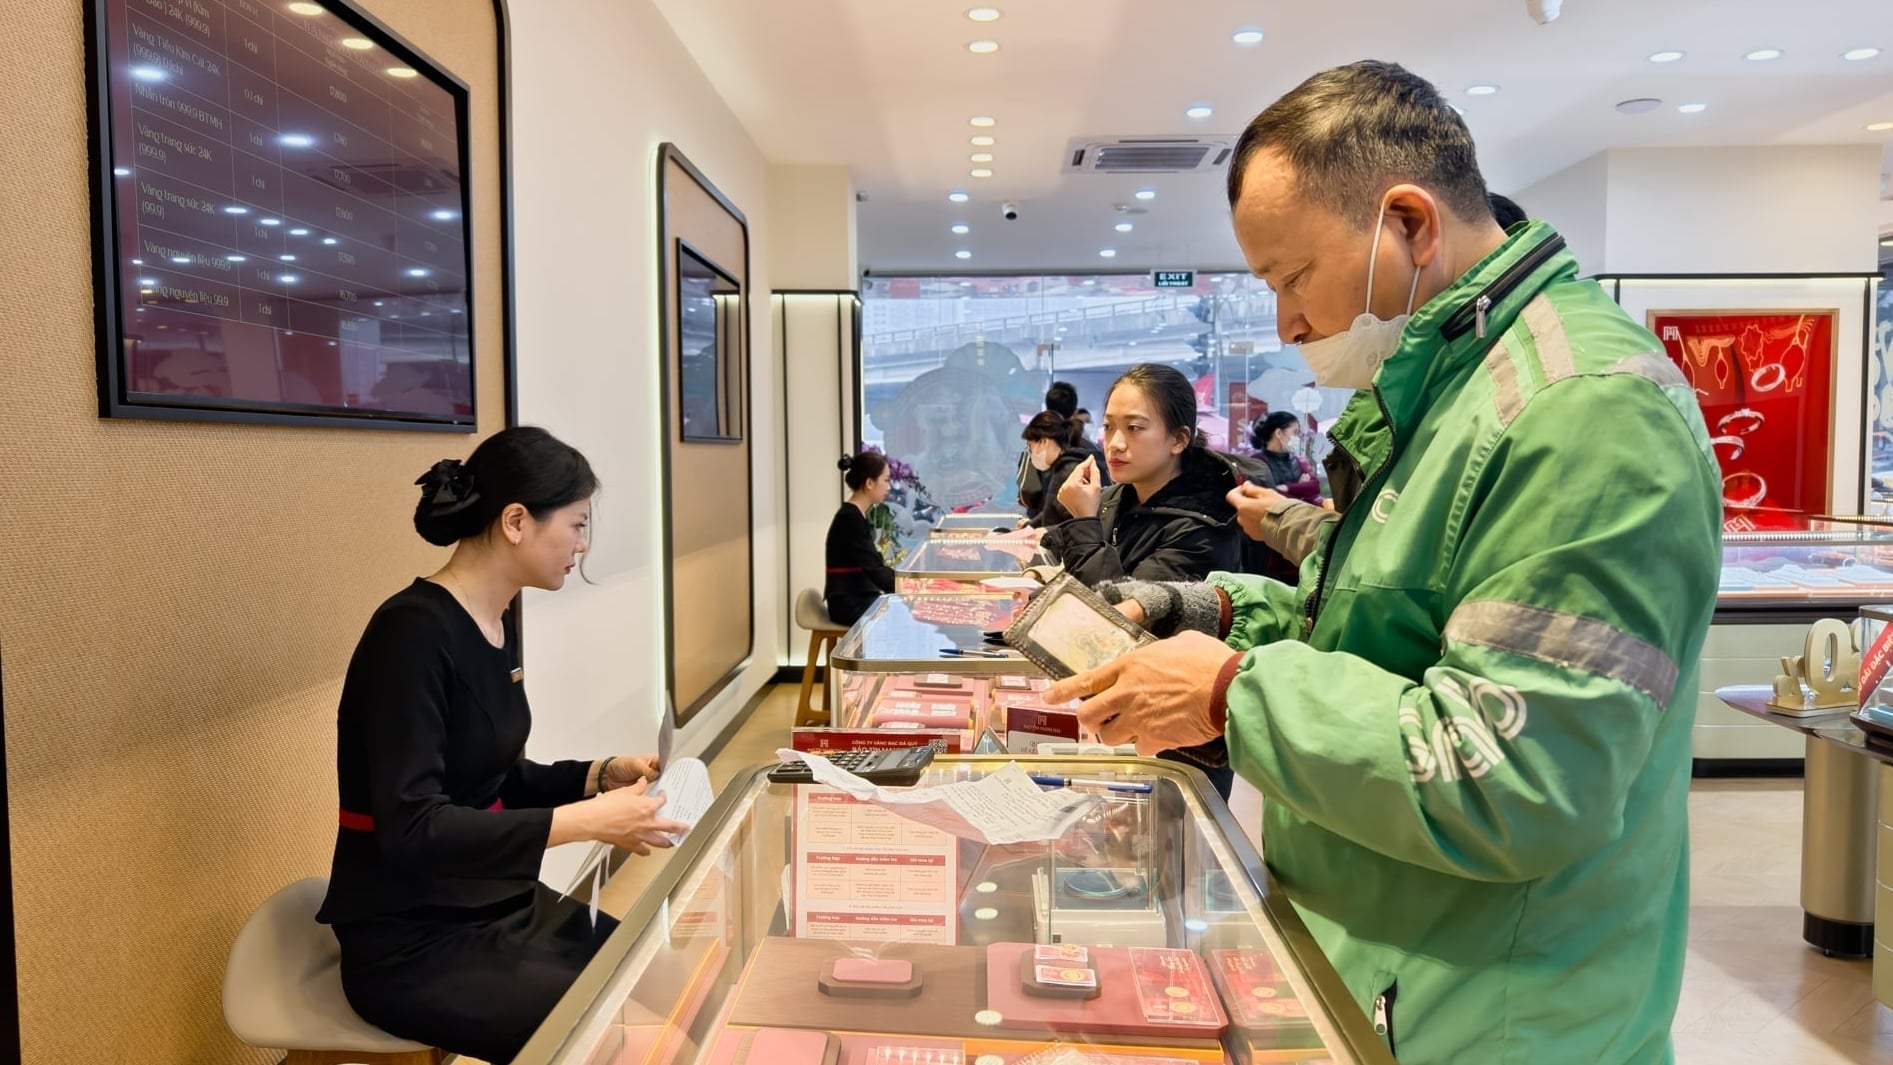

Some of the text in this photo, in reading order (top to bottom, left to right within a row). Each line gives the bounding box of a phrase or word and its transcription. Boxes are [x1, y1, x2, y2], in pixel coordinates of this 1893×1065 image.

[132, 22, 155, 47] Vàng
[207, 61, 221, 77] 24K
[198, 110, 223, 130] BTMH
[137, 122, 161, 145] Vàng
[162, 133, 183, 154] trang
[198, 147, 213, 162] 24K
[139, 142, 167, 165] (999.9)
[140, 181, 164, 201] Vàng
[164, 189, 185, 211] trang
[201, 203, 215, 217] 24K
[142, 200, 165, 221] (99.9)
[144, 239, 166, 259] Vàng
